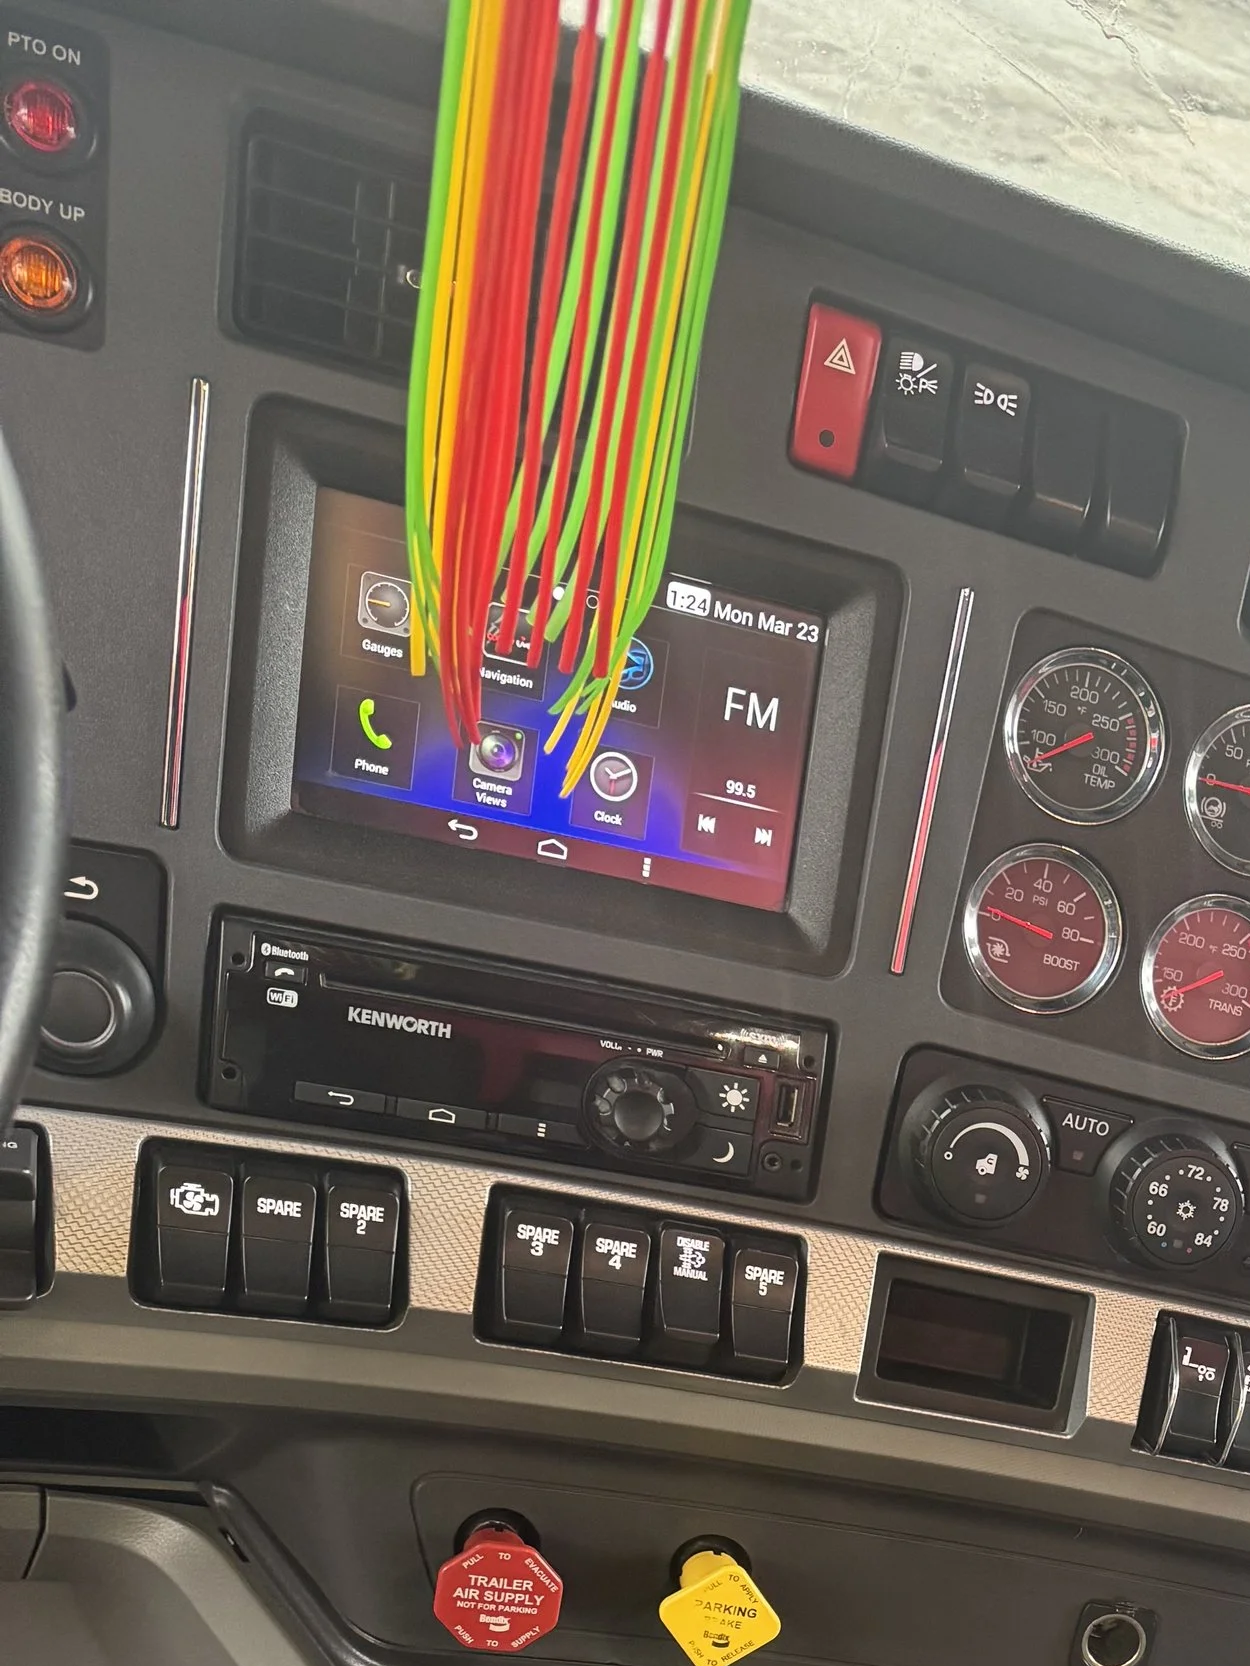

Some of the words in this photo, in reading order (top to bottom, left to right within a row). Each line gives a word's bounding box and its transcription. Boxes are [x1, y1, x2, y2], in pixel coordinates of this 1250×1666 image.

[7, 31, 46, 55] PTO
[52, 45, 82, 66] ON
[0, 187, 54, 215] BODY
[59, 202, 86, 222] UP
[671, 590, 707, 613] 1:24
[714, 601, 753, 626] Mon
[757, 612, 793, 636] Mar
[796, 622, 820, 643] 23
[362, 639, 403, 658] Gauges
[1070, 686, 1099, 704] 200
[723, 686, 779, 731] FM
[1043, 701, 1067, 717] 150
[1091, 714, 1120, 731] 250
[1030, 729, 1056, 746] 100
[1091, 747, 1120, 764] 300
[1225, 745, 1244, 760] 50
[354, 759, 389, 776] Phone
[1091, 763, 1108, 778] OIL
[472, 778, 513, 796] Camera
[725, 779, 757, 799] 99.5
[1083, 773, 1116, 790] TEMP
[476, 792, 507, 808] Views
[594, 811, 622, 826] Clock
[1033, 878, 1053, 893] 40
[1004, 887, 1024, 902] 20
[1032, 895, 1048, 907] PSI
[1057, 900, 1076, 916] 60
[1061, 927, 1080, 942] 80
[1178, 933, 1205, 949] 200
[271, 945, 309, 961] Bluetooth
[1221, 943, 1247, 960] 250
[1043, 953, 1080, 971] BOOST
[1163, 967, 1183, 982] 150
[1221, 983, 1248, 999] 300
[1208, 998, 1244, 1017] TRANS
[347, 1006, 452, 1038] KENWORTH
[646, 1047, 663, 1058] PWR
[1062, 1113, 1109, 1137] AUTO
[1186, 1165, 1204, 1181] 72
[1149, 1181, 1168, 1198] 66
[257, 1197, 302, 1218] SPARE
[339, 1202, 385, 1224] SPARE
[1213, 1197, 1230, 1212] 78
[356, 1220, 366, 1235] 2
[516, 1224, 560, 1246] SPARE
[1147, 1221, 1167, 1236] 60
[595, 1237, 638, 1259] SPARE
[676, 1236, 710, 1252] DISABLE
[1194, 1233, 1213, 1247] 84
[530, 1241, 543, 1257] 3
[608, 1255, 622, 1270] 4
[673, 1266, 708, 1282] MANUAL
[744, 1265, 785, 1286] SPARE
[757, 1281, 768, 1296] 5
[462, 1553, 484, 1569] PULL
[498, 1552, 512, 1560] TO
[524, 1557, 559, 1593] EVACUATE
[468, 1574, 534, 1592] TRAILER
[728, 1574, 740, 1583] TO
[740, 1583, 759, 1605] APPLY
[452, 1587, 480, 1600] AIR
[483, 1590, 545, 1606] SUPPLY
[456, 1600, 477, 1609] NOT
[477, 1602, 496, 1611] FOR
[498, 1604, 538, 1615] PARKING
[454, 1624, 474, 1645] PUSH
[486, 1639, 499, 1648] TO
[510, 1625, 541, 1648] SUPPLY
[707, 1659, 718, 1666] TO
[721, 1640, 755, 1663] RELEASE
